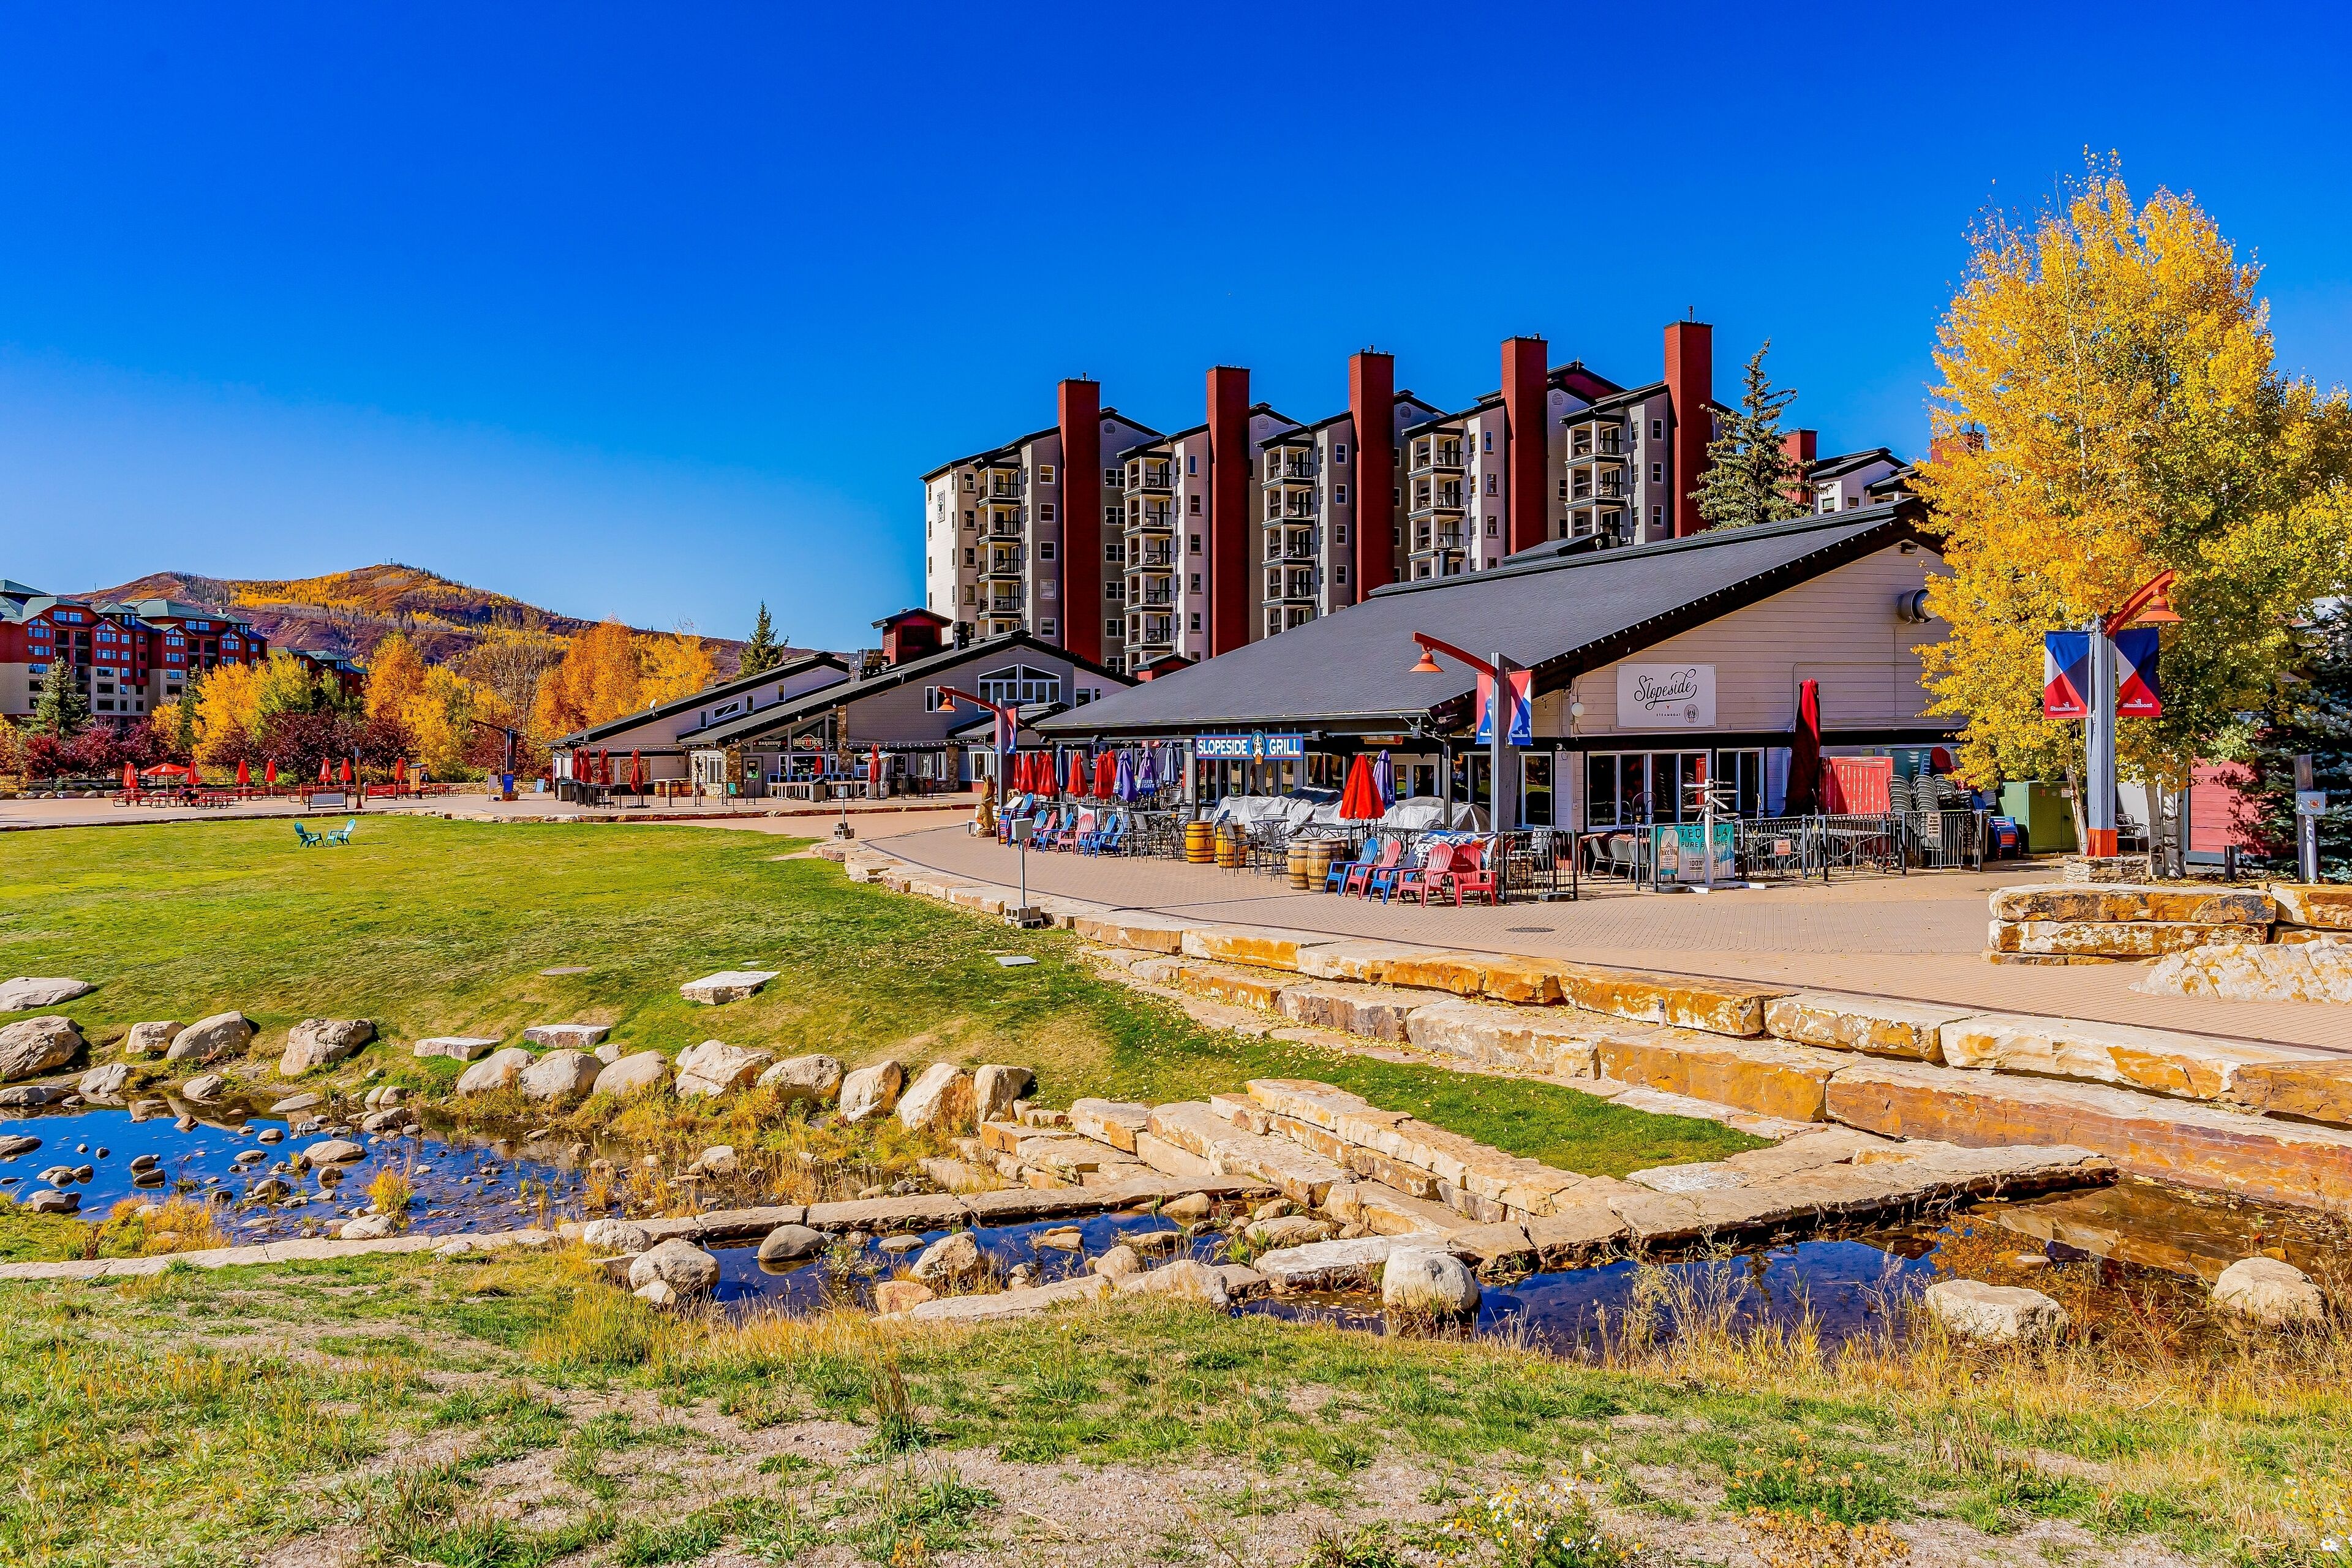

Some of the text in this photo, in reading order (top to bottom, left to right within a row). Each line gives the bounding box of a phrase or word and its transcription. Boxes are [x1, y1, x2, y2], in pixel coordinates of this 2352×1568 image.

[1634, 668, 1697, 710] Slopeside
[2049, 703, 2080, 711] Steamboat
[1197, 739, 1300, 755] SLOPESIDE GRILL
